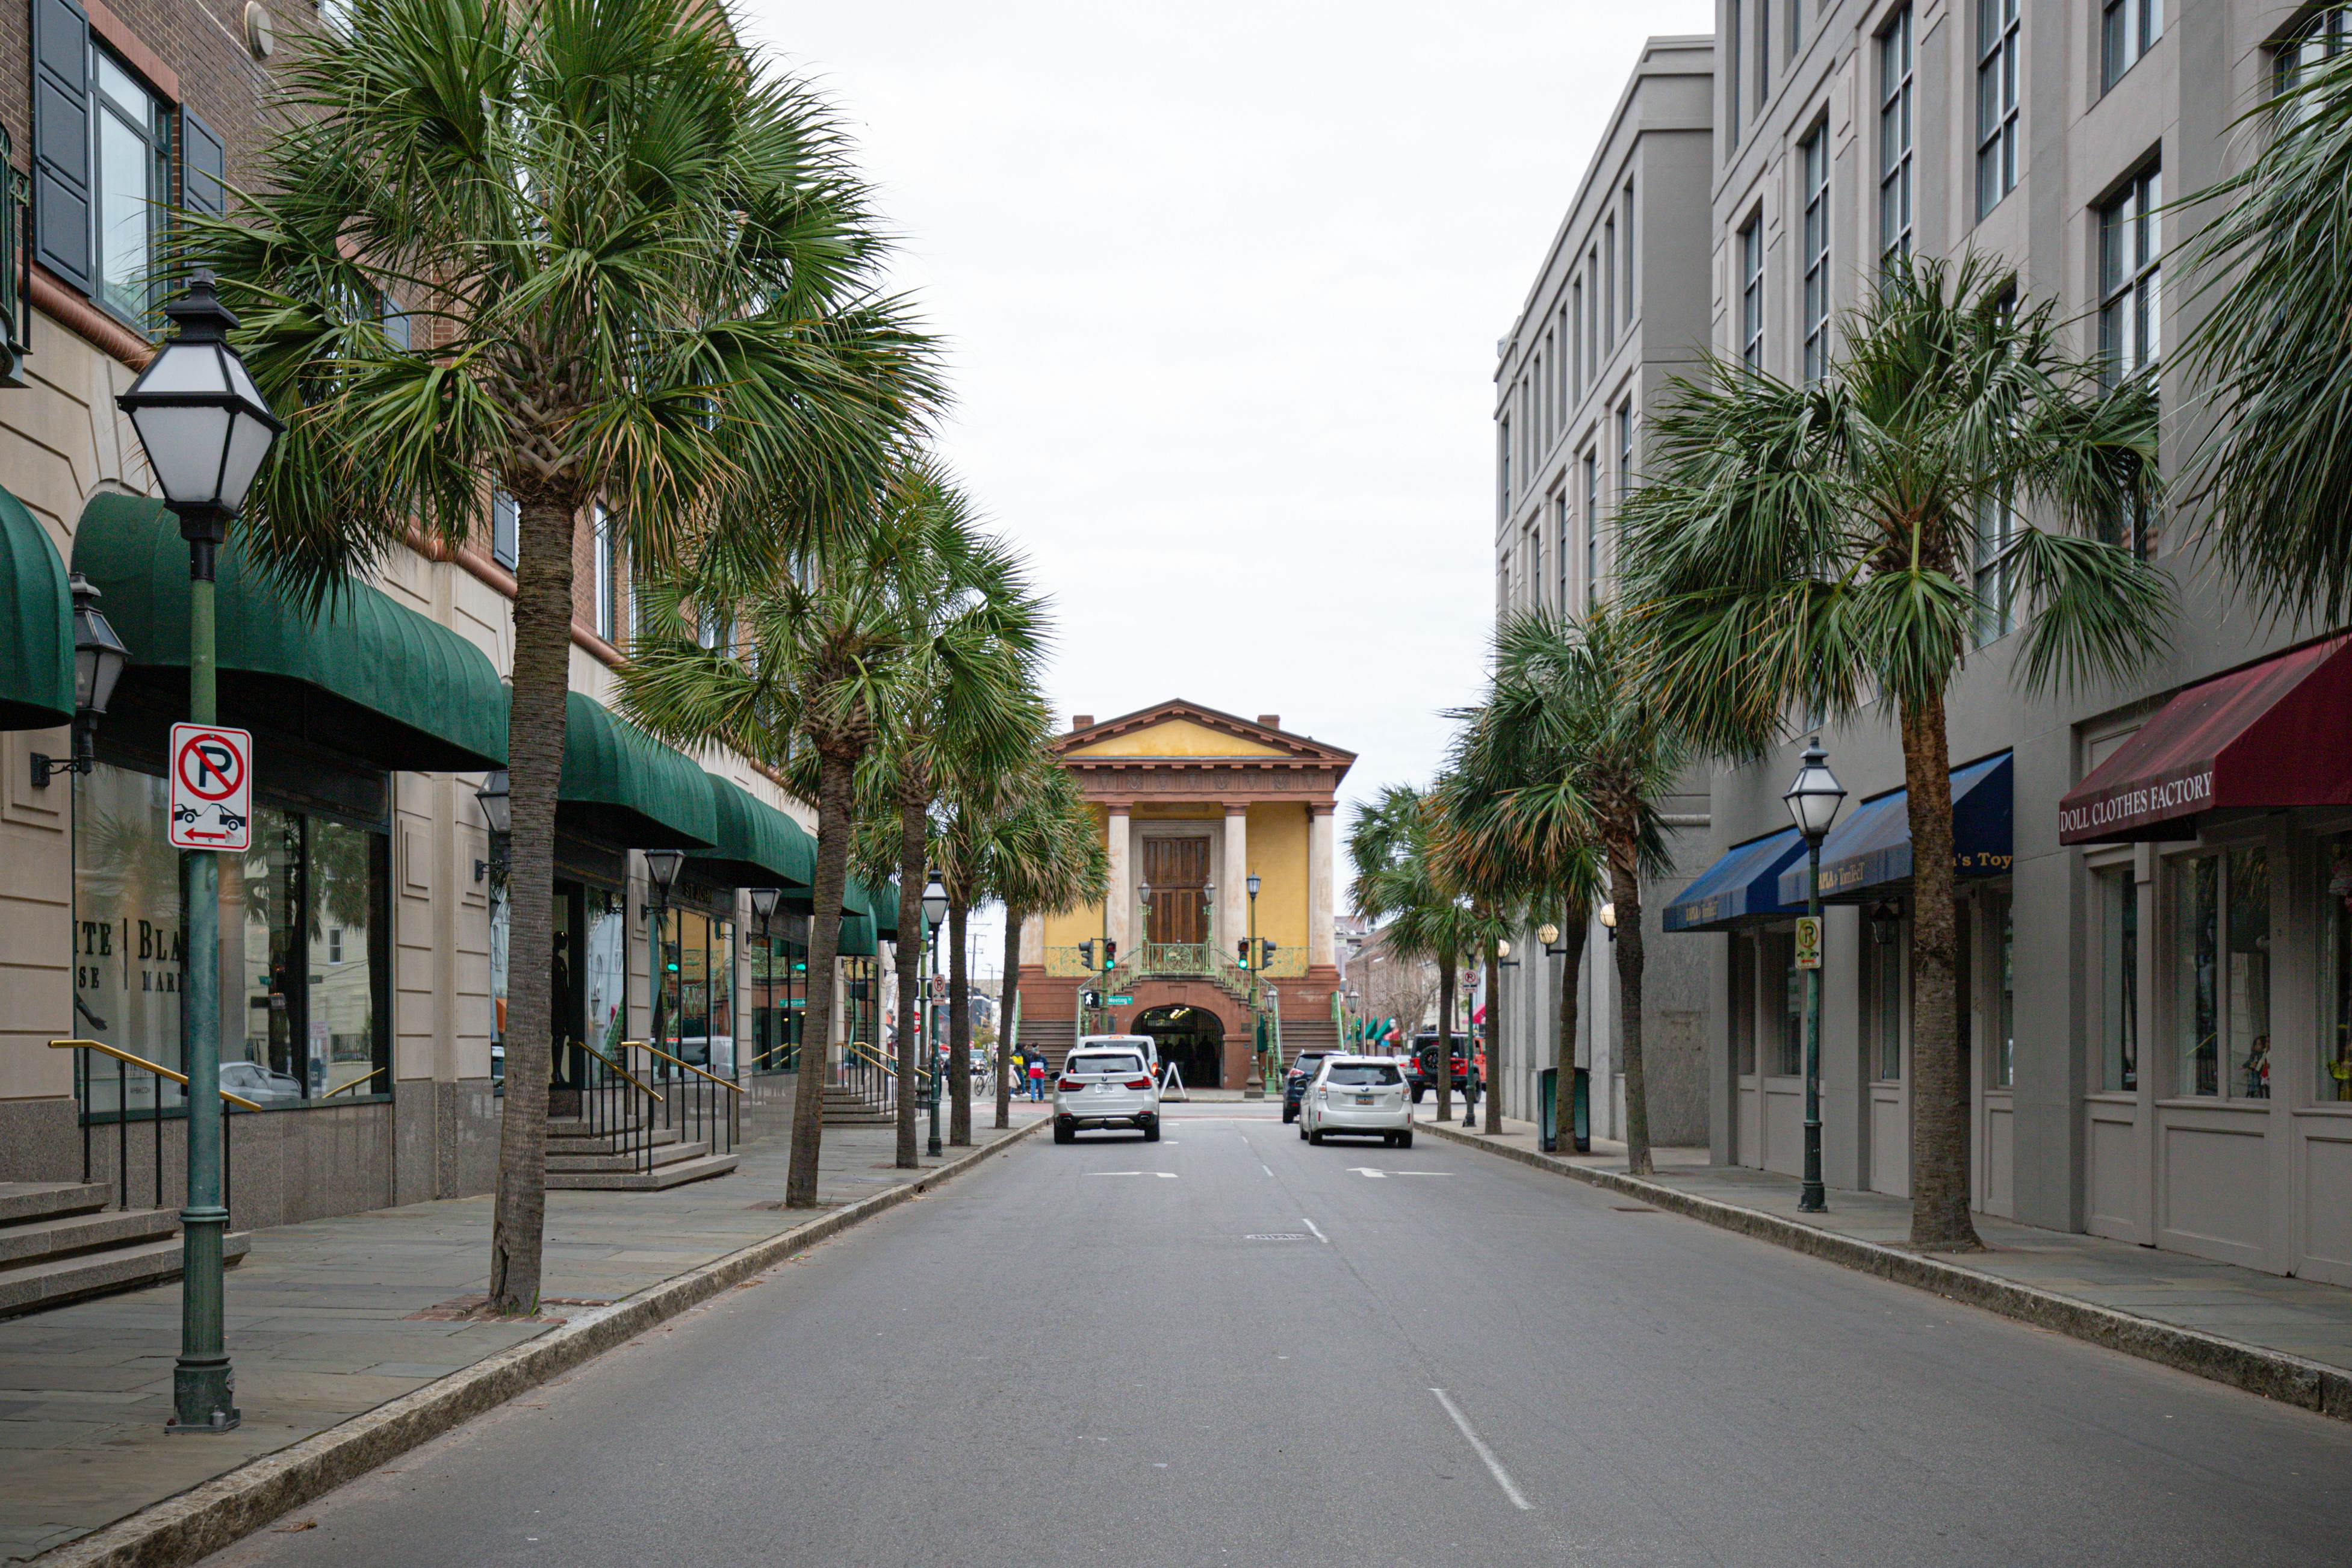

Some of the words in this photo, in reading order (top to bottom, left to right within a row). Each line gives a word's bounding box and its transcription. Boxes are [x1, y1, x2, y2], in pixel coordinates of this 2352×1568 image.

[2060, 807, 2090, 832] DOLL
[2092, 789, 2147, 826] CLOTHES
[2151, 771, 2213, 810] FACTORY
[1977, 852, 2012, 869] Toy
